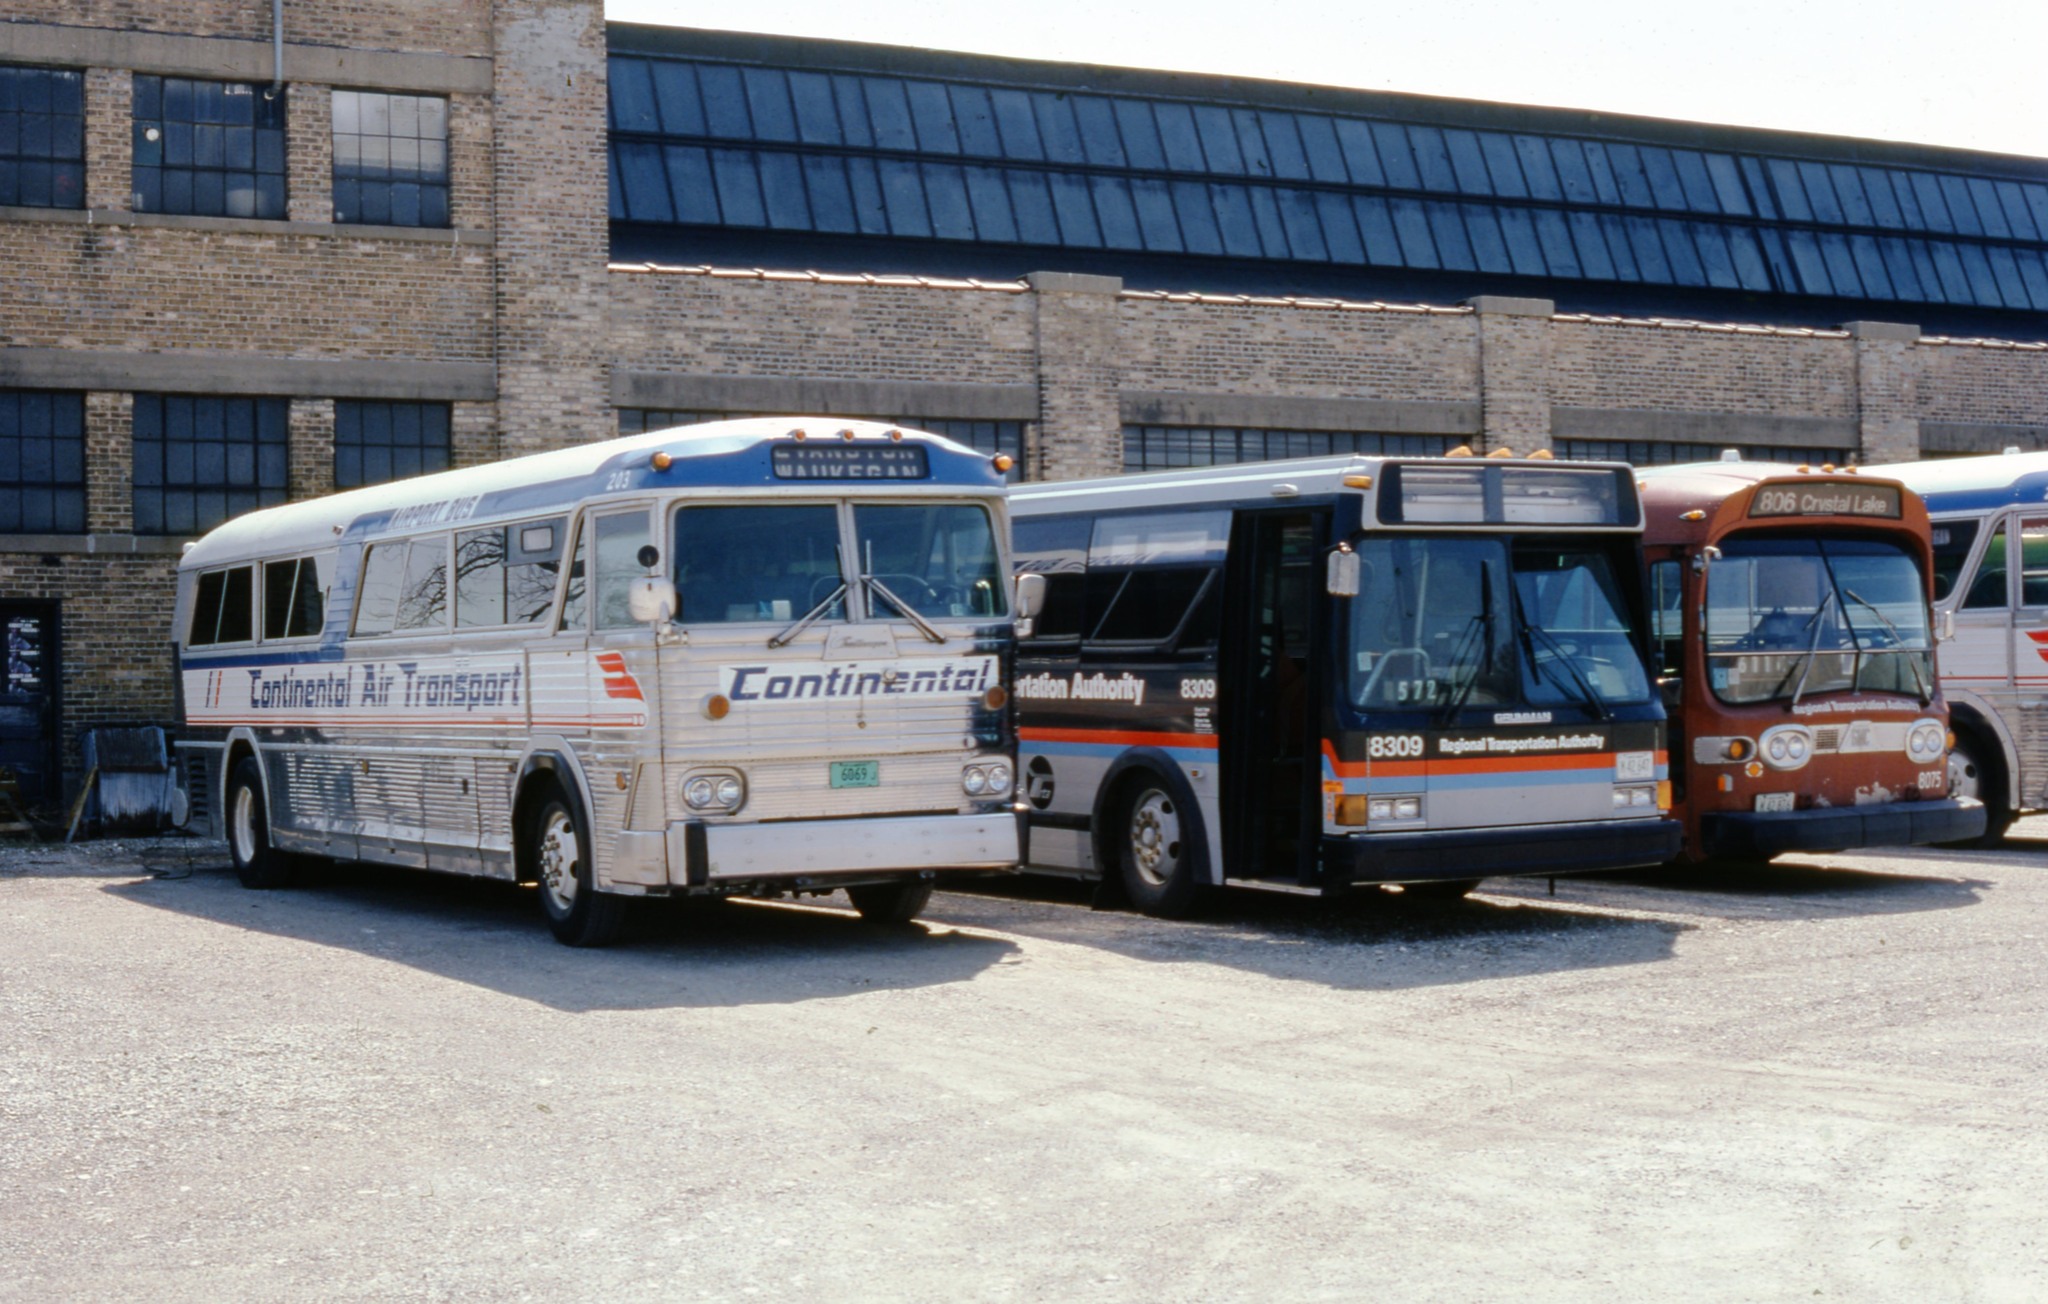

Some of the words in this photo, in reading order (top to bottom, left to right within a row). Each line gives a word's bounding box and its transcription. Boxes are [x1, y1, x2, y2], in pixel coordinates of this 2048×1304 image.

[606, 470, 630, 490] 203
[1760, 491, 1797, 513] 806
[1801, 494, 1850, 513] Crystal
[1853, 495, 1887, 513] Lake
[247, 666, 353, 709] Continental
[360, 663, 394, 707] Air
[397, 662, 521, 711] Transport
[728, 659, 991, 701] Continental
[1070, 672, 1145, 706] Authority
[1181, 678, 1216, 699] 8309
[1370, 735, 1424, 757] 8309
[1439, 737, 1486, 755] Regional
[1487, 735, 1557, 753] Transportation
[1558, 733, 1605, 750] Authority
[841, 767, 868, 781] 6069
[1918, 771, 1942, 790] 8075
